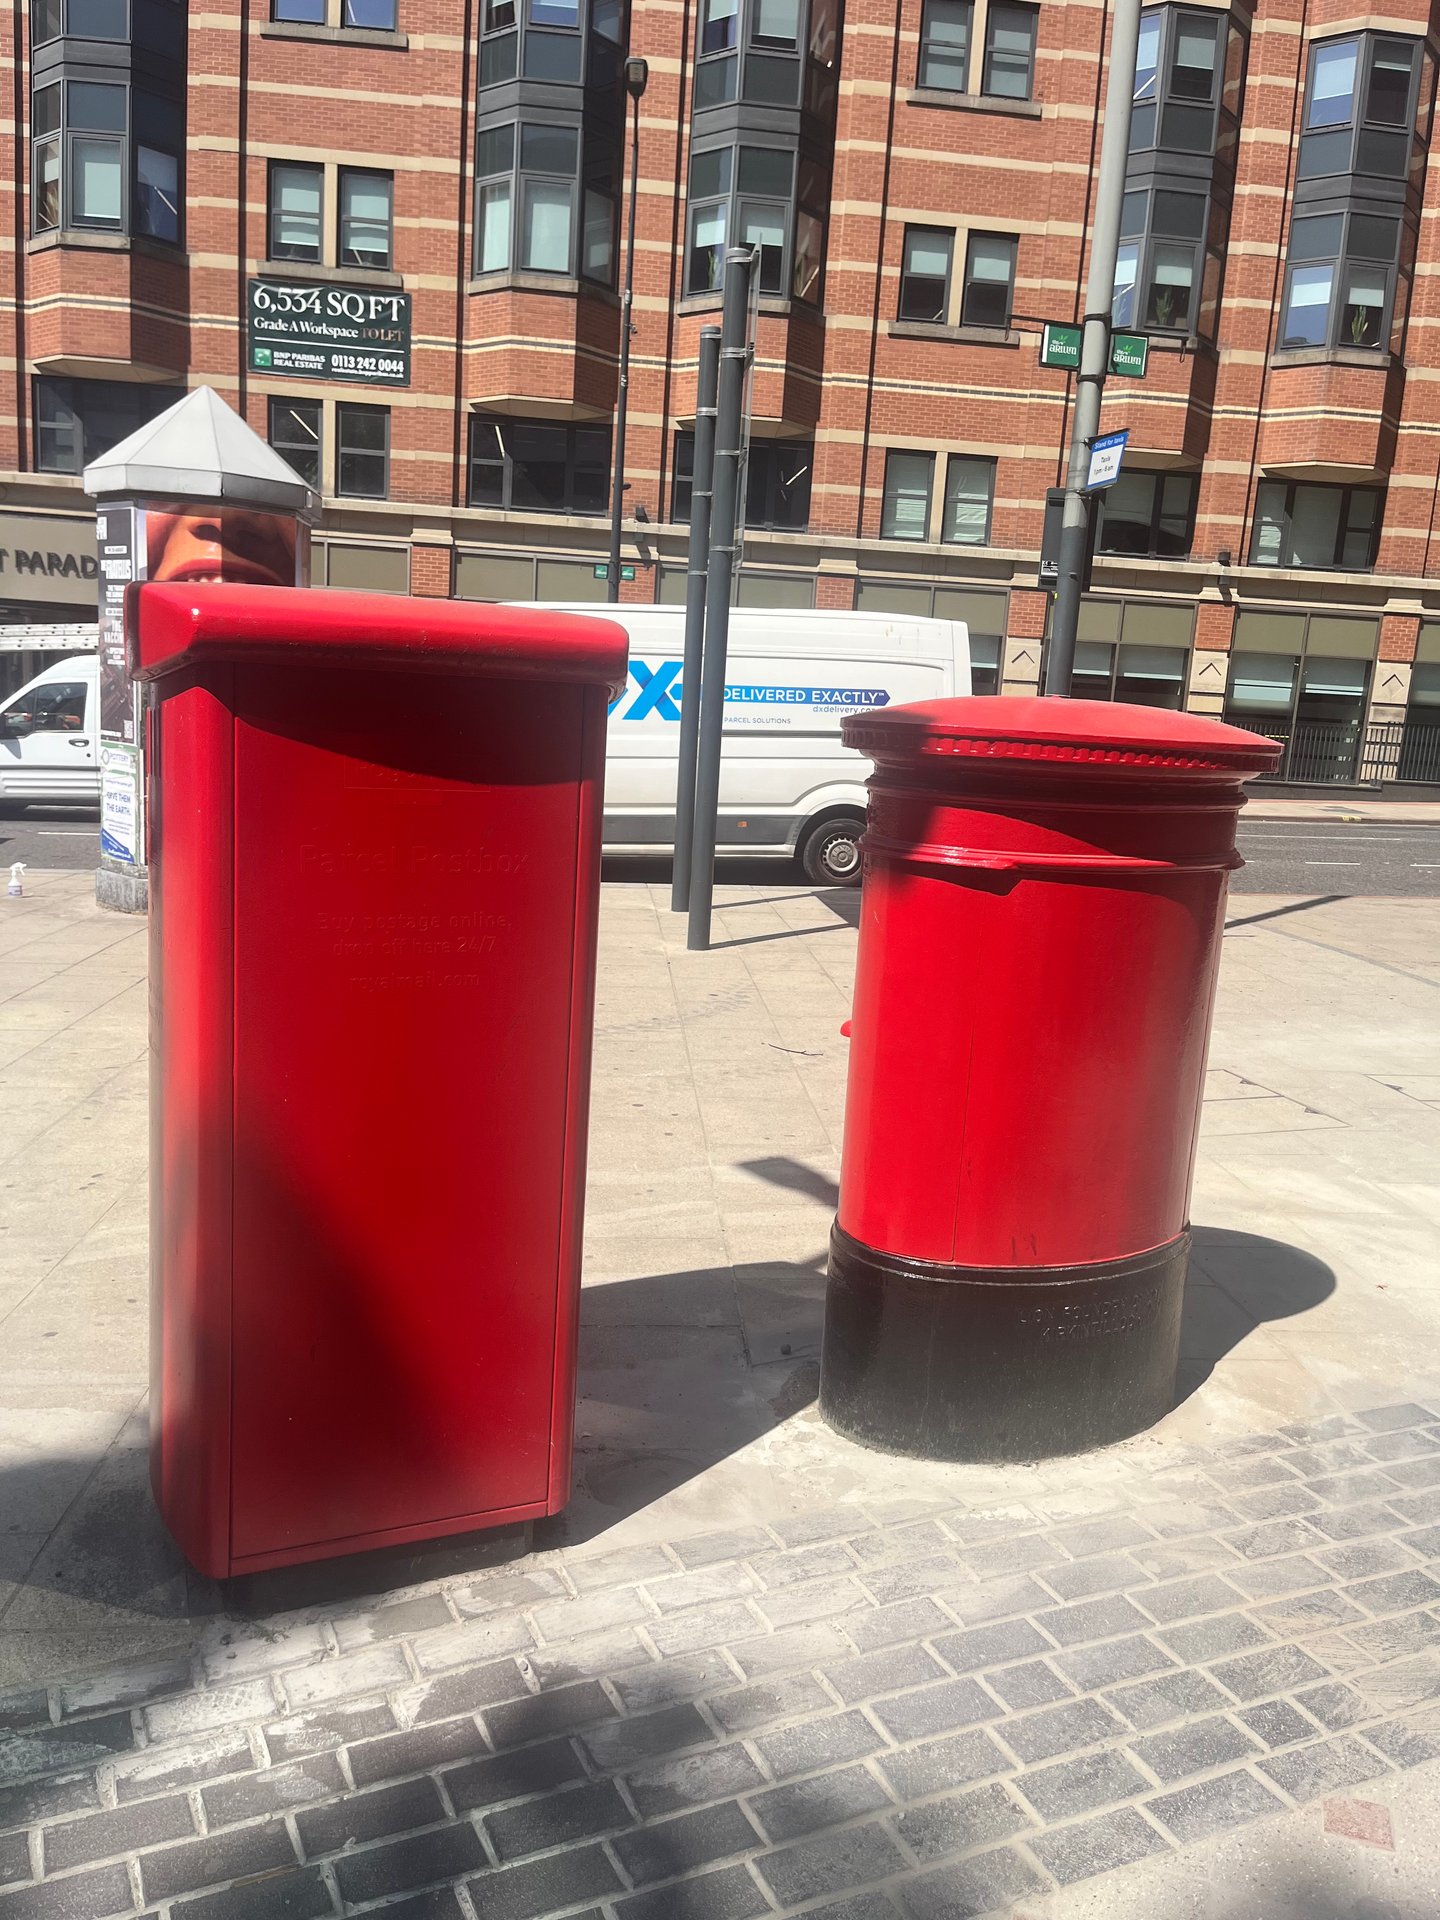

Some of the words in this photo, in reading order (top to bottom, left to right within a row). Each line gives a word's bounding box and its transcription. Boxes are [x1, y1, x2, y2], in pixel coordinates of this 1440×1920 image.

[253, 286, 323, 314] 6,534
[326, 292, 366, 323] SQ
[368, 296, 406, 322] FT
[254, 317, 289, 332] Grade
[289, 321, 299, 333] A
[299, 321, 359, 339] Workspace
[361, 327, 379, 339] TO
[380, 328, 405, 342] LET
[273, 351, 291, 359] BNP
[291, 352, 326, 363] PARIBAS
[273, 358, 295, 367] REAL
[294, 360, 323, 370] ESTATE
[331, 354, 355, 368] 0113
[356, 356, 376, 370] 242
[378, 358, 404, 373] 0044
[15, 549, 98, 580] PARAD
[724, 688, 807, 702] DELIVERED
[812, 705, 877, 715] dxdelivery.co
[752, 717, 791, 725] SOLUTIONS
[299, 844, 397, 874] Parcel
[411, 844, 529, 874] Postbox
[456, 935, 497, 954] 24/7
